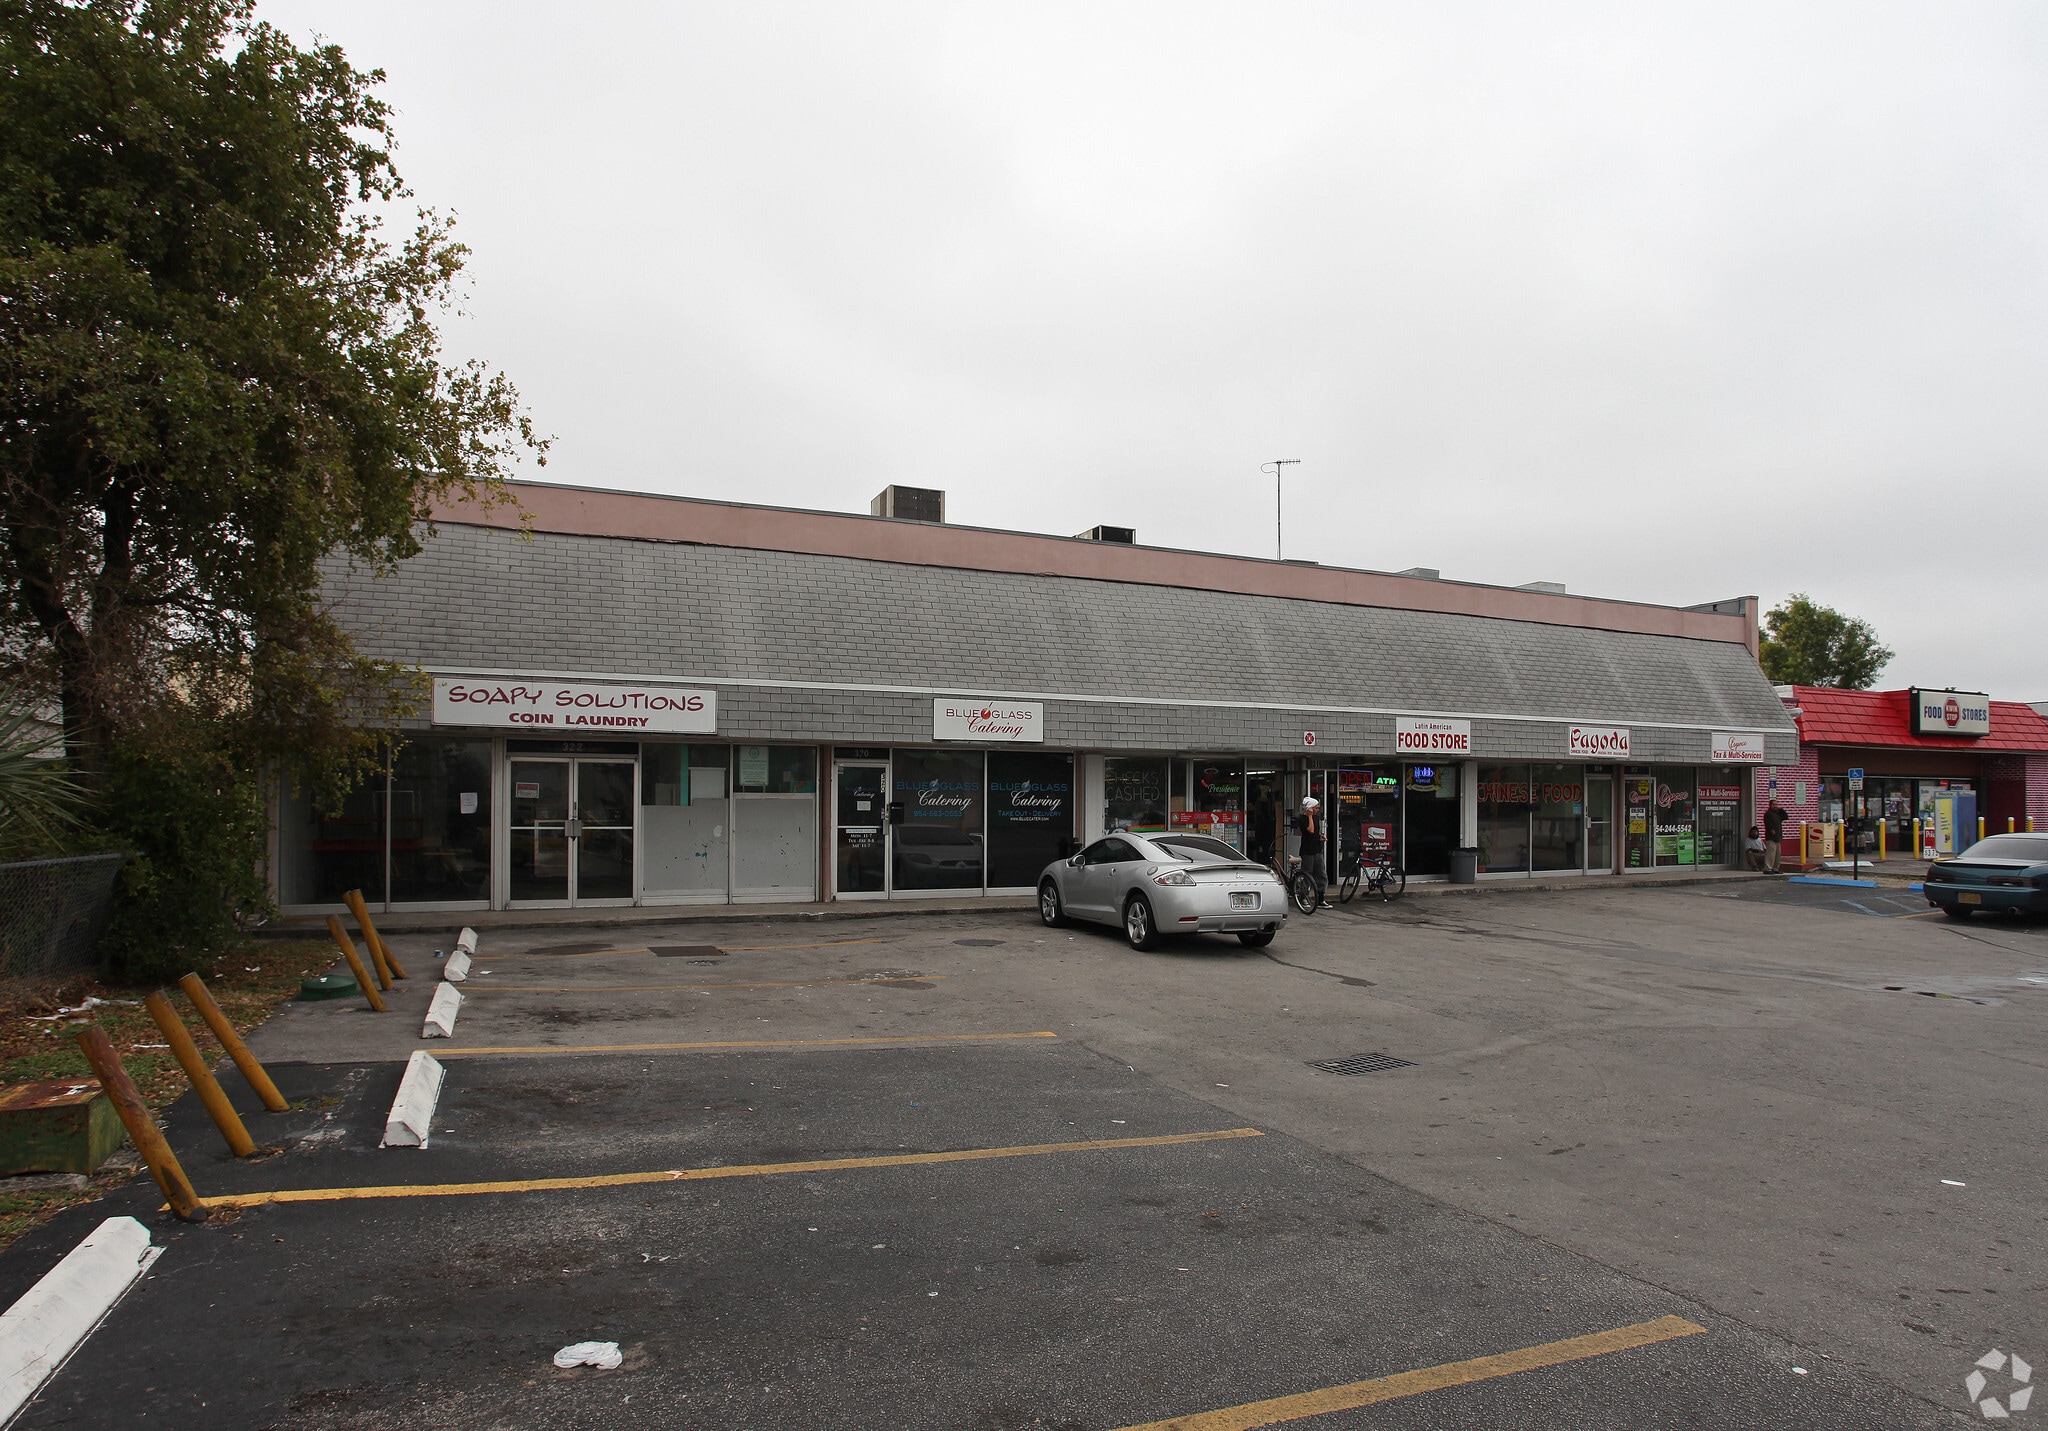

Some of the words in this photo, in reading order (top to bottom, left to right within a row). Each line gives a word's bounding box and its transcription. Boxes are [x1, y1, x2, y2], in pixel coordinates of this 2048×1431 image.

[448, 685, 543, 705] SOAPY
[555, 689, 705, 711] SOLUTIONS
[508, 712, 554, 724] COIN
[565, 714, 650, 727] LAUNDRY
[946, 708, 981, 718] BLUE
[991, 710, 1033, 720] GLASS
[1924, 706, 1942, 719] FOOD
[1962, 708, 1987, 721] STORES
[966, 716, 1024, 739] Catering
[562, 742, 583, 752] 322
[1398, 732, 1429, 748] FOOD
[1431, 733, 1468, 749] STORE
[1570, 728, 1628, 754] Pagoda
[854, 749, 869, 757] 320
[1713, 750, 1722, 758] Tax
[1728, 751, 1762, 759] Multi-Services
[1105, 770, 1160, 785] CHECKS
[1339, 771, 1371, 787] OPEN
[896, 781, 929, 790] BLUE
[940, 782, 981, 791] GLASS
[990, 782, 1022, 791] BLUE
[1031, 783, 1069, 792] GLASS
[1105, 785, 1160, 802] CASHED
[1208, 783, 1241, 793] Presidente
[1477, 782, 1540, 803] CHINESE
[1542, 783, 1584, 803] FOOD
[1711, 789, 1740, 797] Multi-Services
[917, 789, 973, 811] Catering
[1010, 790, 1062, 811] Catering
[1655, 824, 1692, 833] 54-244-5542
